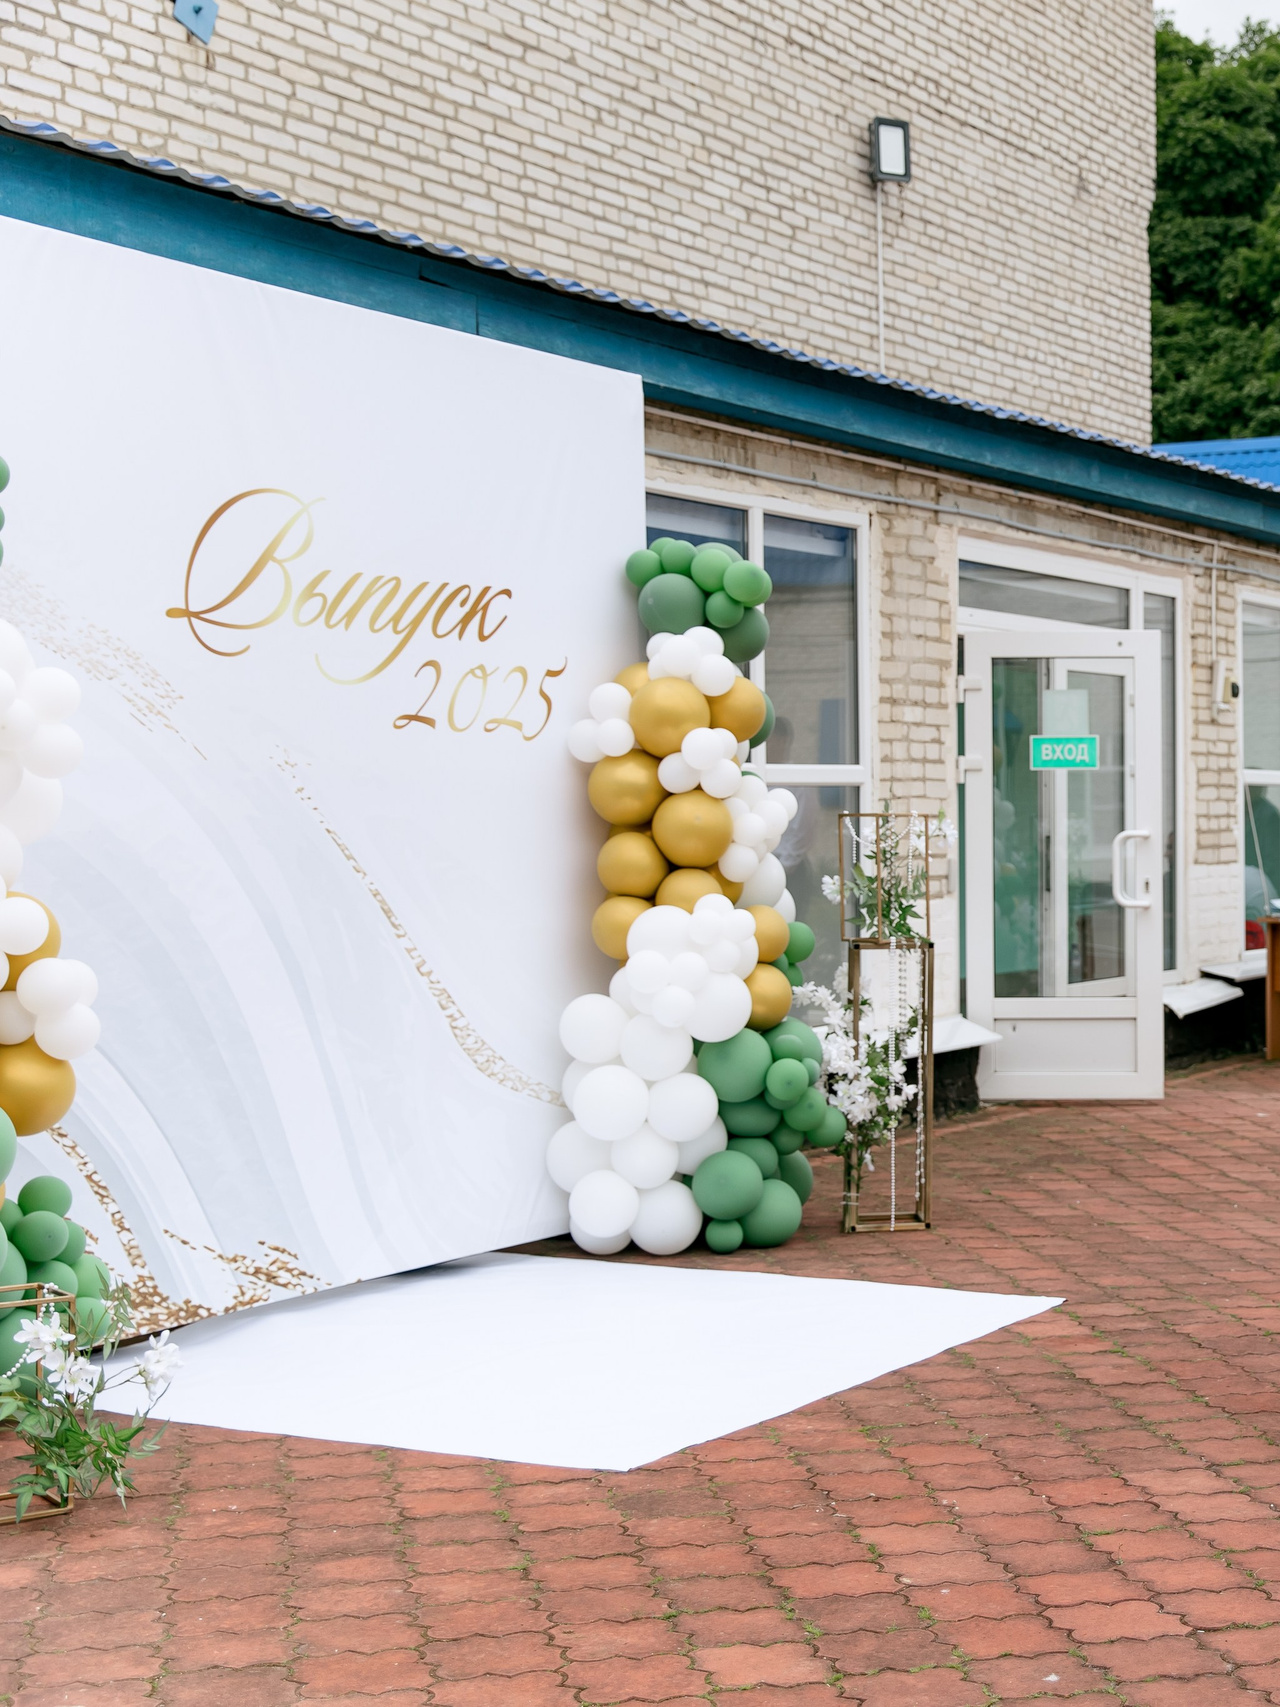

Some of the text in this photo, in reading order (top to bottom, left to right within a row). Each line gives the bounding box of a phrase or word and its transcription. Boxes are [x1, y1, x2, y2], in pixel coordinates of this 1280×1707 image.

[165, 487, 512, 685] Выпуск
[393, 656, 568, 742] 2025
[1041, 743, 1089, 763] ВХОД
